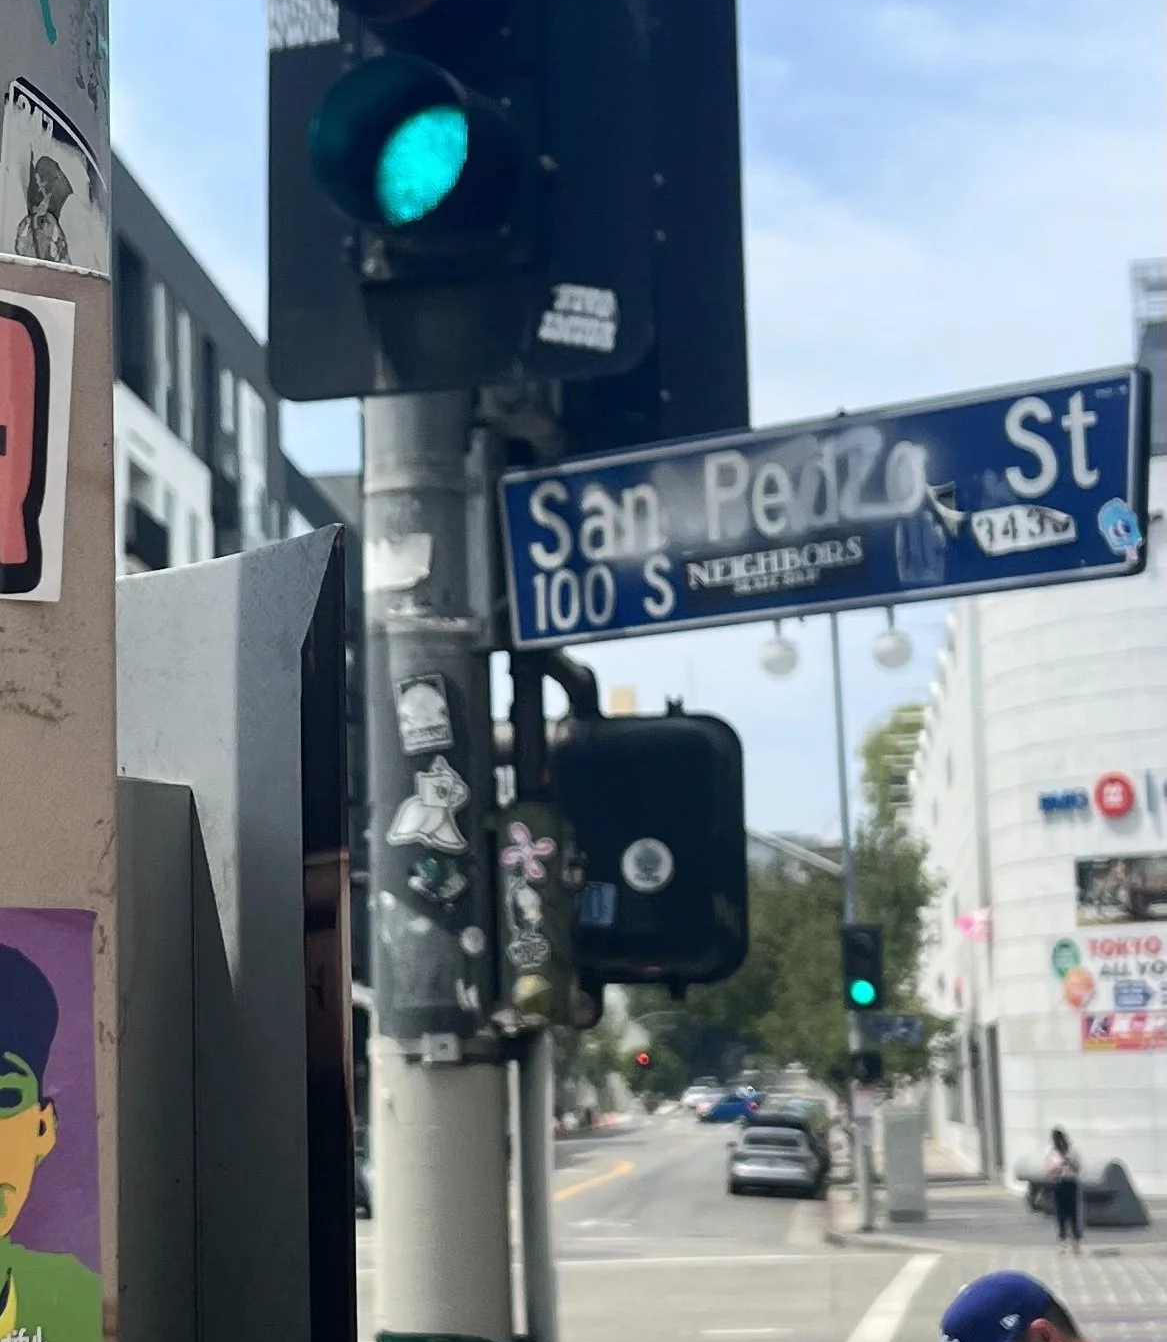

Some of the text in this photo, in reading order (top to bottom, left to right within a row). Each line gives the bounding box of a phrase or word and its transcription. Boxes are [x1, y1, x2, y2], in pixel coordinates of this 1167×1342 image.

[529, 479, 670, 571] San
[1004, 390, 1100, 499] St
[534, 563, 616, 634] 100
[642, 553, 676, 619] S
